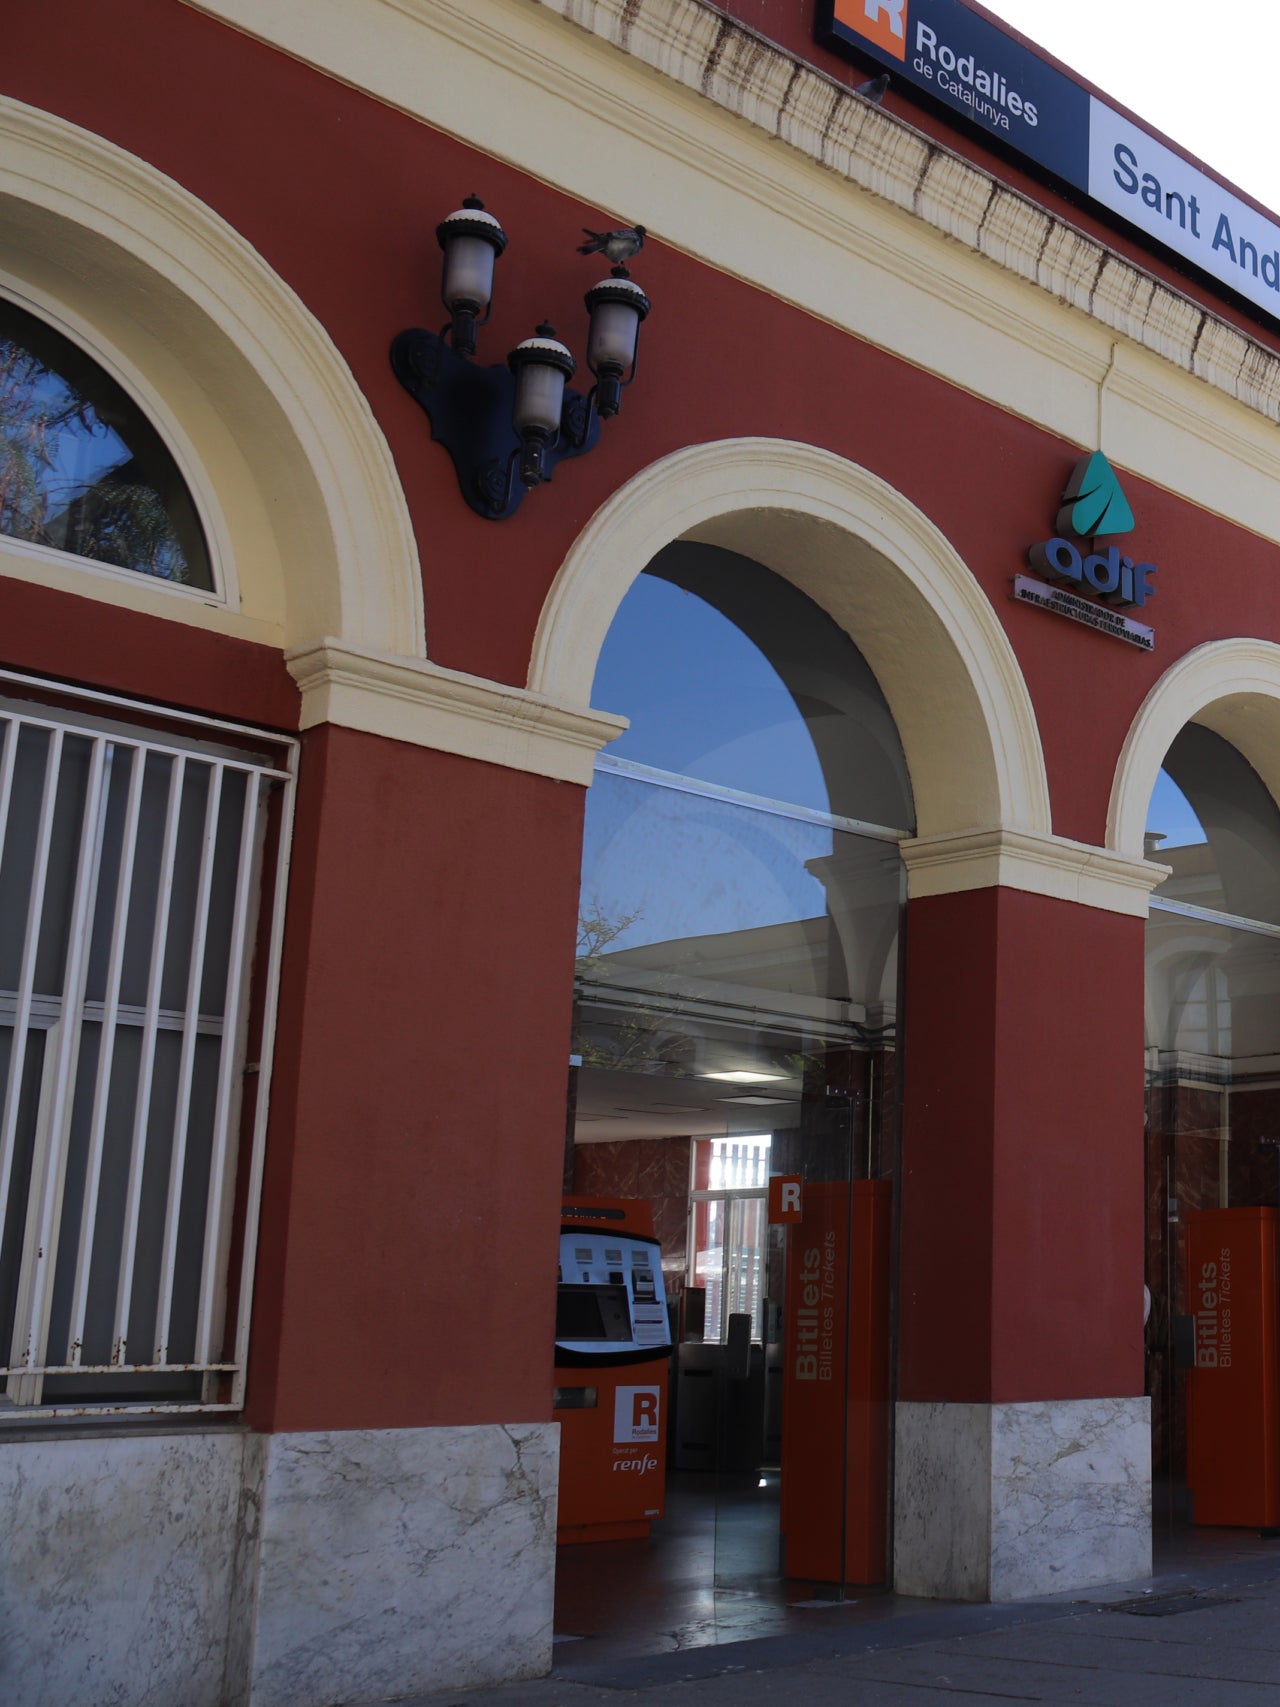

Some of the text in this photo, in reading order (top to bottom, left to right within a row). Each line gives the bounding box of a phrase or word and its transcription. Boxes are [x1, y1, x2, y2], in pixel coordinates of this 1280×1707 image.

[913, 57, 1011, 131] de Catalunya
[916, 21, 1039, 127] Rodalies
[1112, 142, 1201, 239] Sant
[1043, 537, 1159, 607] adif
[781, 1182, 801, 1212] R
[795, 1247, 821, 1381] Bitllets
[818, 1230, 836, 1381] Billetes Tickets
[1196, 1261, 1218, 1369] Bitllets
[1219, 1247, 1232, 1369] Billetes Tickets
[632, 1392, 658, 1427] R
[612, 1452, 658, 1476] renfe
